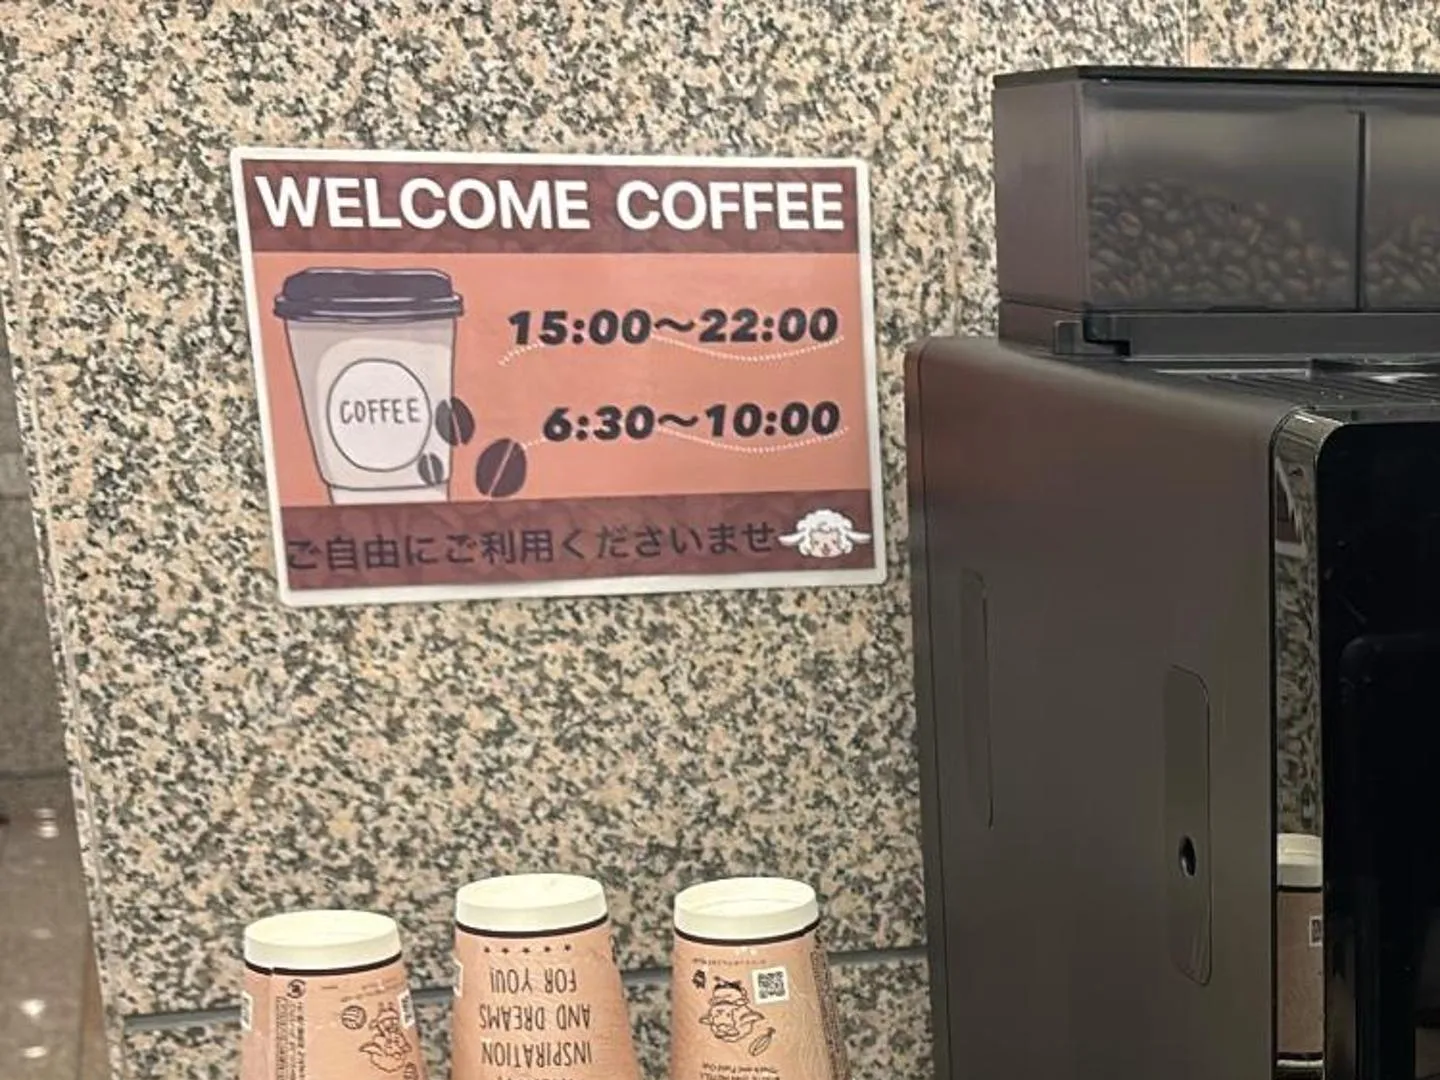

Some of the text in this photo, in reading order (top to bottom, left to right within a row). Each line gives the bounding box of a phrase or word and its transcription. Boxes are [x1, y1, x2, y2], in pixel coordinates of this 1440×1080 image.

[254, 176, 845, 231] WELCOME COFFEE
[340, 397, 421, 424] COFFEE
[286, 521, 777, 570] ご自由にご利用くださいませ
[490, 966, 577, 994] FOR YOU!
[479, 1003, 591, 1032] AND DREAMS
[481, 1041, 592, 1069] INSPIRATION
